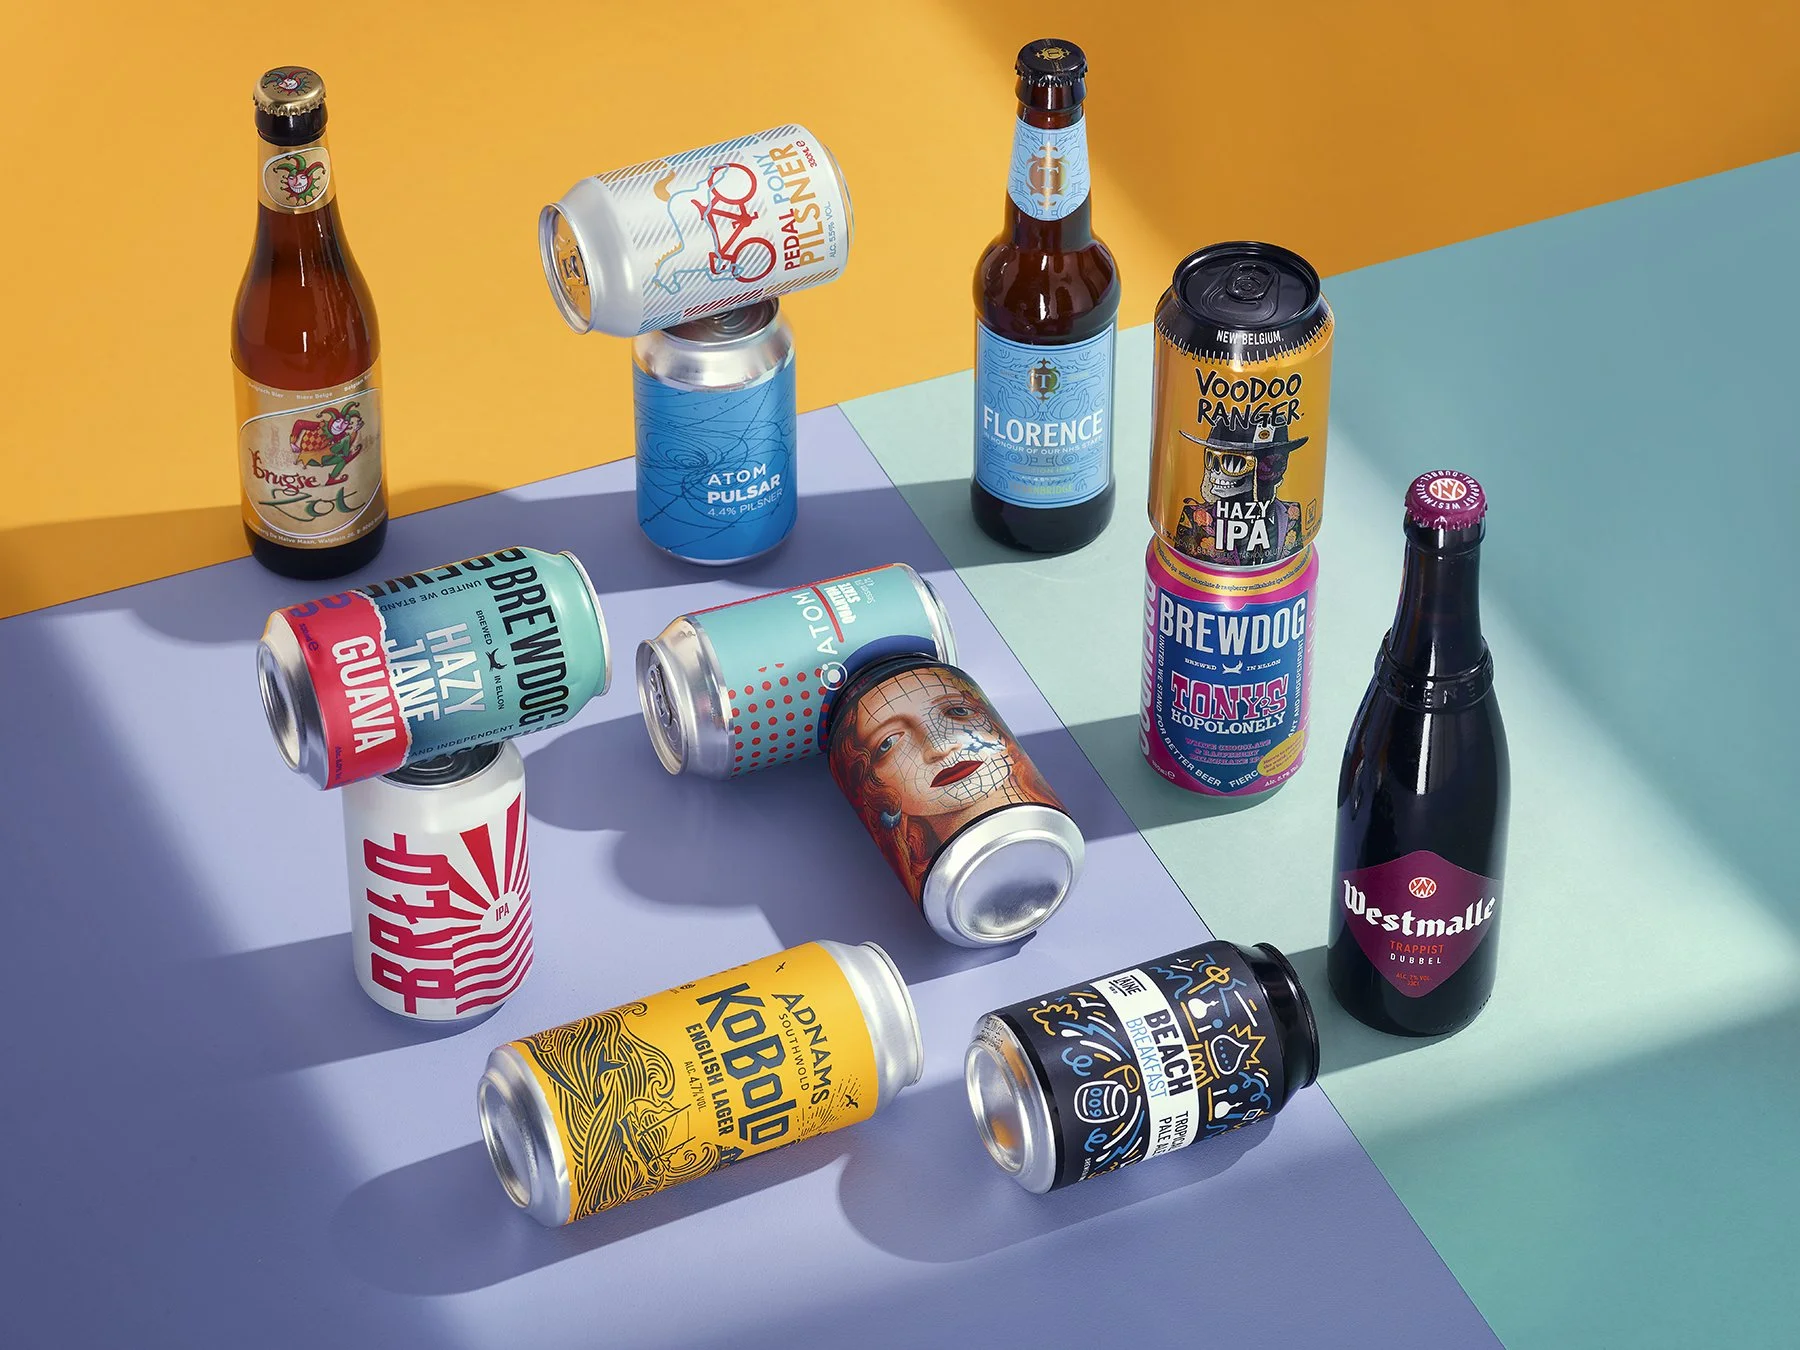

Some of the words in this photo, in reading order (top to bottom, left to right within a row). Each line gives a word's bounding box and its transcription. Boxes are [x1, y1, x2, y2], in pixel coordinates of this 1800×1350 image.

[752, 154, 791, 204] PONY
[769, 144, 824, 266] PILSNER
[778, 208, 800, 270] PEDAL
[1216, 330, 1238, 344] NEW
[1195, 368, 1303, 401] VOODOO
[984, 405, 1104, 446] FLORENCE
[991, 436, 1024, 452] HONOUR
[708, 463, 766, 486] ATOM
[708, 474, 780, 504] PULSAR
[708, 508, 736, 516] 4.4%
[740, 488, 782, 514] PILSNER
[1216, 500, 1270, 520] HAZY
[1216, 519, 1270, 551] IPA
[441, 580, 482, 596] UNITED
[1190, 576, 1216, 588] chocolate
[380, 596, 422, 612] STAND
[420, 592, 438, 603] WE
[476, 610, 492, 645] BREWED
[792, 592, 838, 655] ATOM
[1159, 592, 1306, 656] BREWDOG
[485, 566, 569, 726] BREWDOG
[426, 623, 486, 715] HAZY
[1156, 668, 1164, 680] WE
[1184, 658, 1217, 670] BREWED
[1258, 659, 1281, 670] ELLON
[383, 638, 440, 722] JANE
[494, 674, 501, 684] IN
[331, 636, 396, 754] GUAVA
[496, 685, 504, 710] ELLON
[1156, 714, 1166, 734] FOR
[1171, 708, 1286, 734] HOPOLONELY
[436, 724, 514, 750] INDEPENDENT
[1185, 738, 1218, 750] WHITE
[1220, 739, 1272, 751] CHOCOLATE
[1164, 737, 1195, 770] BETTER
[1195, 767, 1222, 786] BEER
[1228, 770, 1259, 788] FIERC
[496, 902, 510, 922] IPA
[1344, 880, 1496, 937] Westmalle
[1390, 940, 1444, 954] TRAPPIST
[1390, 953, 1441, 964] DUBBEL
[771, 994, 832, 1105] ADNAMS
[778, 1014, 810, 1091] SOUTHWOLD
[1126, 1018, 1168, 1099] BREAKFAST
[1144, 1009, 1194, 1096] BEACH
[684, 1061, 696, 1076] ALC.
[686, 1022, 724, 1086] ENGLISH
[712, 1089, 734, 1136] LAGER
[689, 1076, 704, 1097] 4.7%
[1157, 1116, 1172, 1143] PALE
